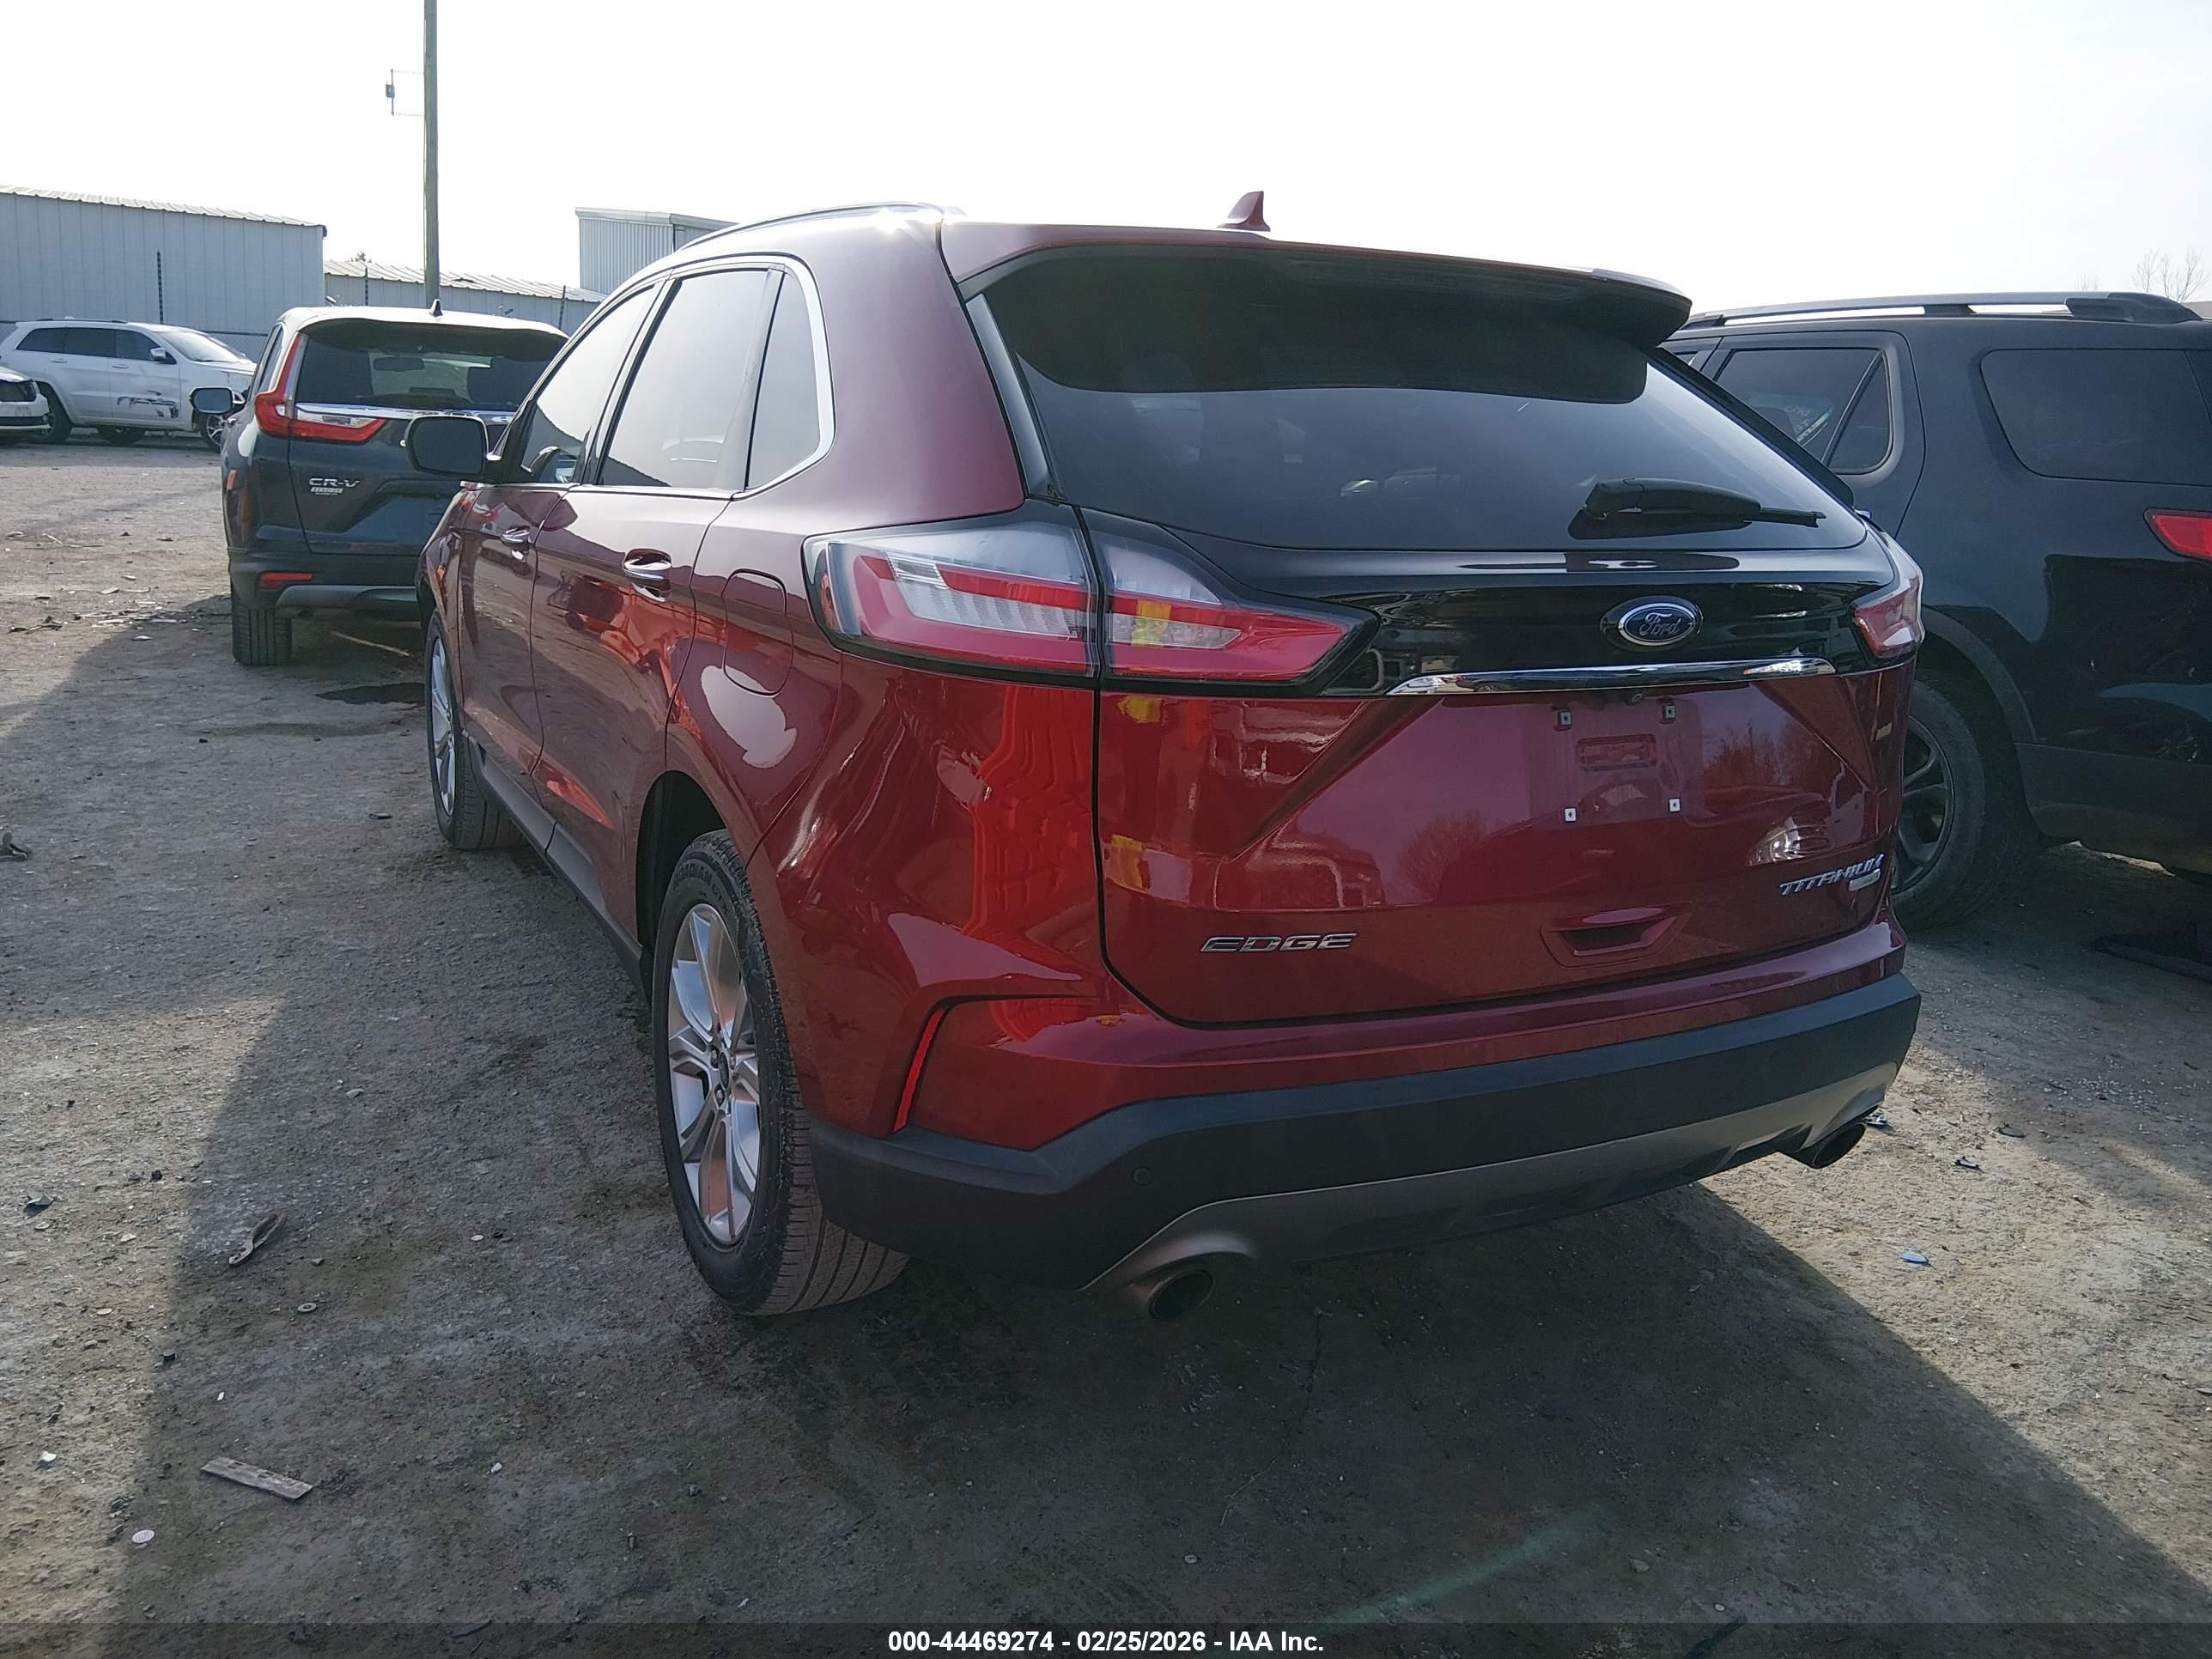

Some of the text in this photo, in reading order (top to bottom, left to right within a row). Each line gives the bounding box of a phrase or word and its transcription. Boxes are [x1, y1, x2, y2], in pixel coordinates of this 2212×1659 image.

[308, 477, 360, 488] CR-V
[1638, 611, 1682, 636] Ford
[1200, 933, 1358, 952] EDGE
